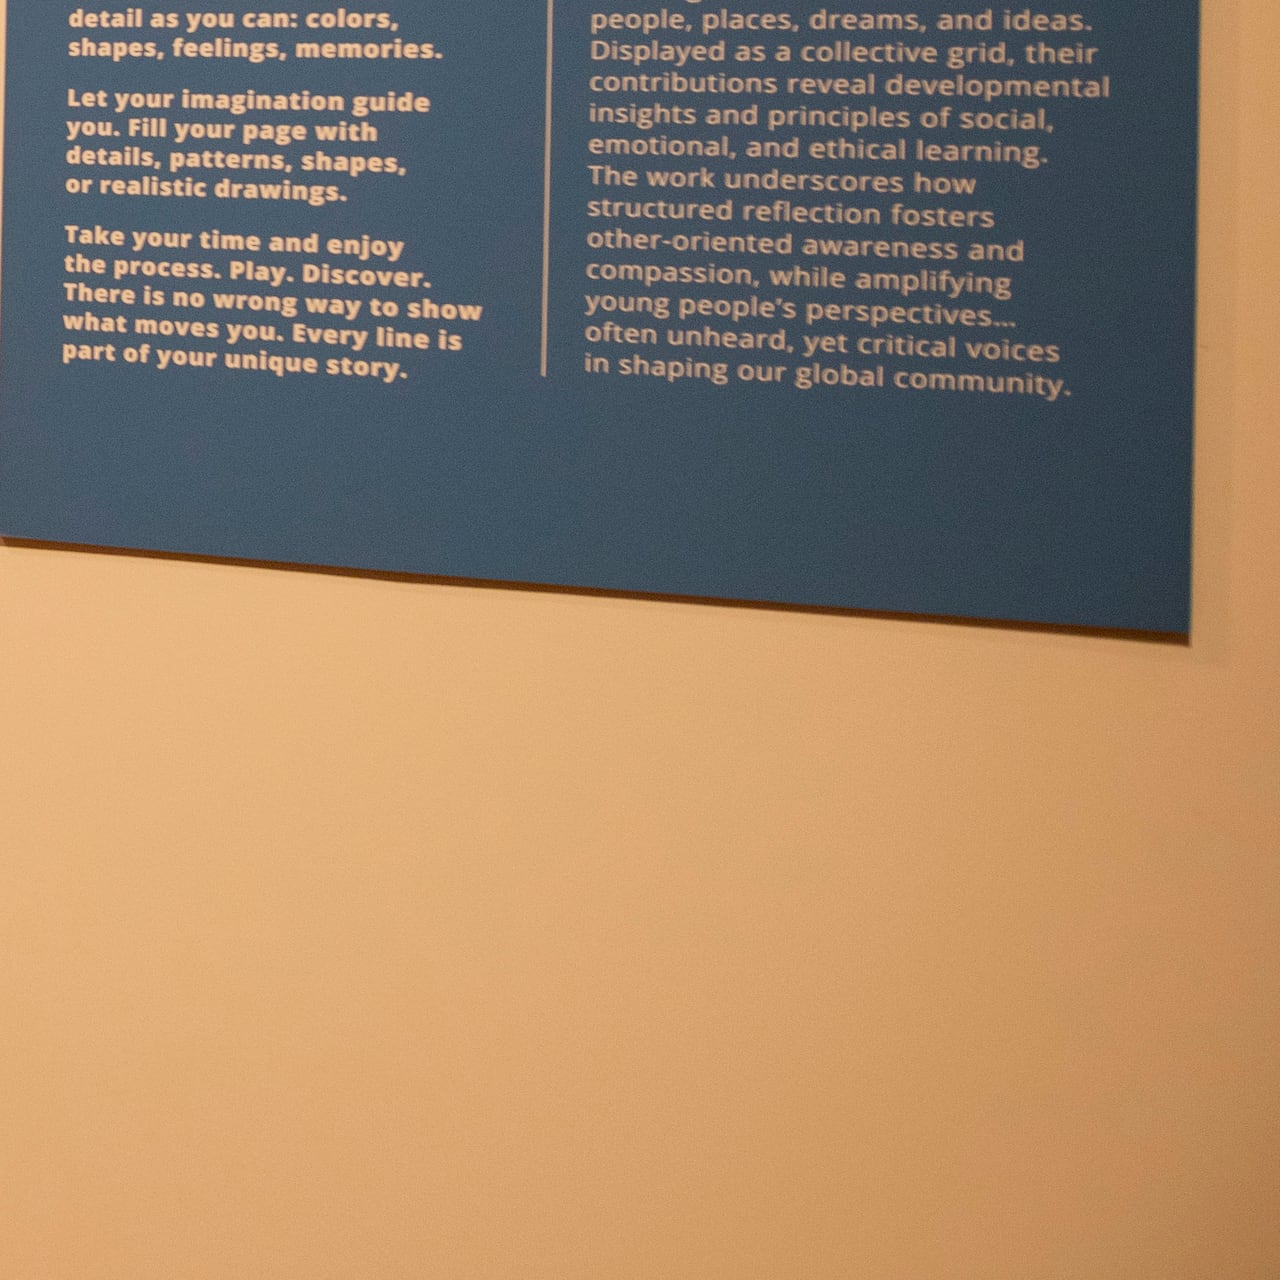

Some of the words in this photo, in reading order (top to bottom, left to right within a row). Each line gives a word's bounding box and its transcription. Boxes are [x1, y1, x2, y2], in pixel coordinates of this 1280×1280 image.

[67, 36, 165, 63] shapes,
[171, 36, 288, 64] feelings,
[295, 37, 444, 60] memories.
[590, 39, 726, 67] Displayed
[734, 45, 767, 62] as
[774, 45, 792, 62] a
[800, 40, 938, 64] collective
[946, 41, 1015, 70] grid,
[1025, 42, 1099, 65] their
[67, 88, 108, 108] Let
[113, 92, 176, 114] your
[181, 88, 345, 116] imagination
[351, 90, 431, 118] guide
[589, 71, 778, 94] contributions
[787, 73, 875, 95] reveal
[884, 73, 1110, 102] developmental
[65, 144, 162, 170] details,
[169, 150, 293, 174] patterns,
[300, 150, 407, 178] shapes,
[588, 135, 737, 160] emotional,
[745, 136, 800, 159] and
[809, 137, 906, 161] ethical
[916, 139, 1048, 170] learning.
[65, 177, 94, 194] or
[99, 175, 208, 198] realistic
[213, 177, 348, 207] drawings.
[586, 164, 639, 187] The
[646, 166, 715, 188] work
[724, 168, 904, 194] underscores
[914, 171, 977, 195] how
[587, 199, 733, 221] structured
[742, 199, 881, 225] reflection
[891, 202, 995, 229] fosters
[586, 227, 793, 255] other-oriented
[802, 238, 959, 260] awareness
[967, 239, 1025, 262] and
[63, 252, 107, 275] the
[113, 259, 222, 281] process.
[229, 260, 295, 288] Play.
[302, 262, 432, 289] Discover.
[585, 263, 760, 288] compassion,
[768, 265, 846, 289] while
[854, 269, 1012, 301] amplifying
[62, 281, 137, 305] There
[143, 284, 166, 307] is
[172, 291, 206, 309] no
[212, 293, 299, 318] wrong
[304, 297, 363, 321] way
[368, 297, 400, 318] to
[406, 297, 484, 321] show
[584, 294, 670, 320] young
[62, 311, 128, 334] what
[134, 318, 220, 339] moves
[225, 323, 285, 345] you.
[292, 322, 369, 352] Every
[375, 325, 431, 350] line
[437, 328, 463, 352] is
[62, 343, 117, 365] part
[122, 343, 151, 364] of
[155, 348, 218, 370] your
[224, 349, 319, 378] unique
[325, 356, 408, 384] story.
[584, 352, 610, 374] in
[618, 353, 729, 386] shaping
[737, 363, 788, 383] our
[794, 362, 884, 390] global
[893, 371, 1072, 402] community.
